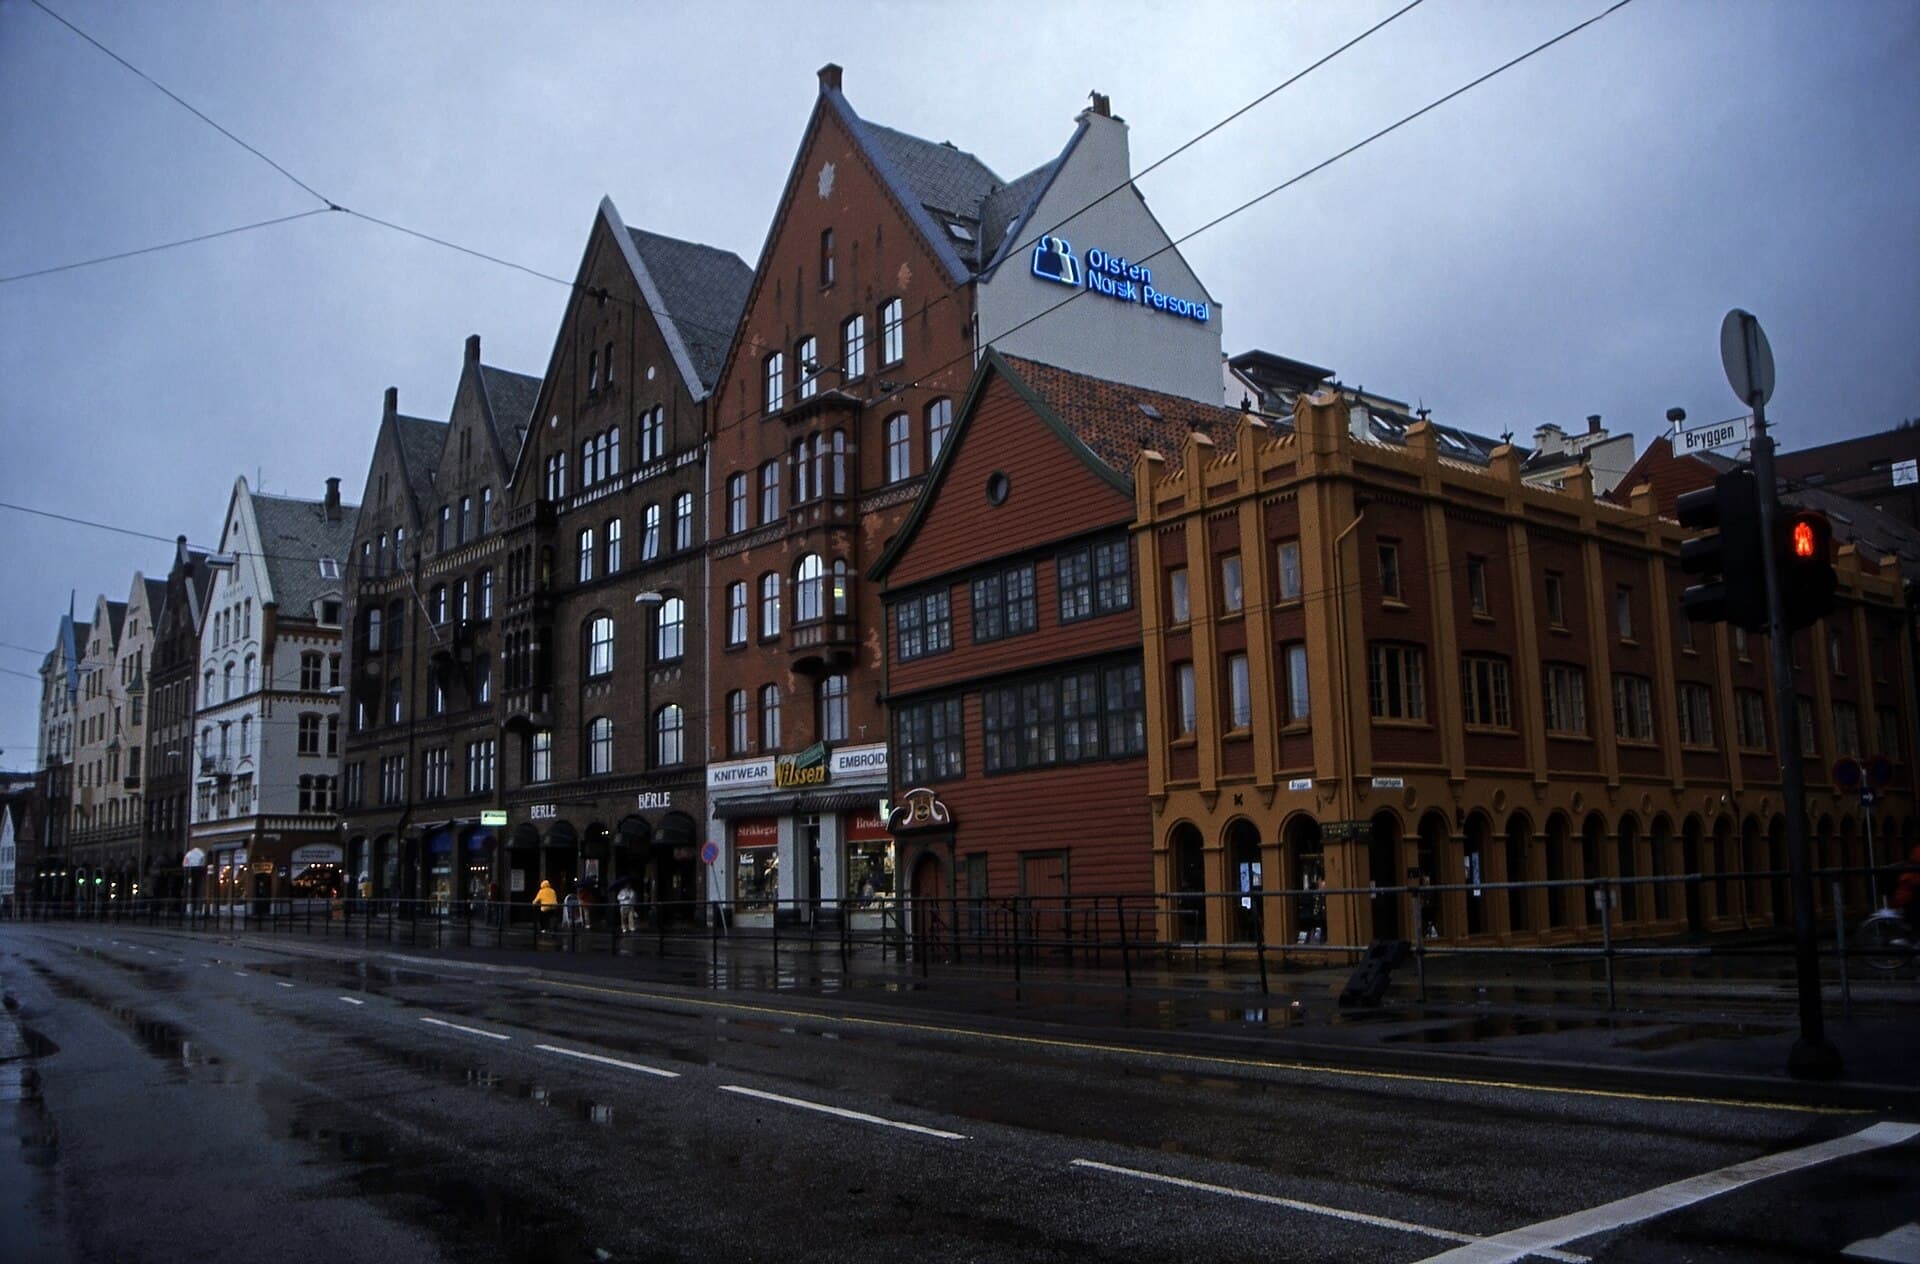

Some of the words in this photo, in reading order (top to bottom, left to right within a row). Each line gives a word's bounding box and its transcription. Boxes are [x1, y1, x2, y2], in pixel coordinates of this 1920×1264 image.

[1089, 248, 1151, 282] Olsten
[1088, 269, 1137, 300] Norsk
[1143, 284, 1210, 321] Personal
[1686, 426, 1734, 448] Bryggen
[840, 752, 887, 769] EMBROID
[714, 766, 768, 782] KNITWEAR
[638, 792, 671, 809] BERLE
[531, 806, 556, 819] BERLE
